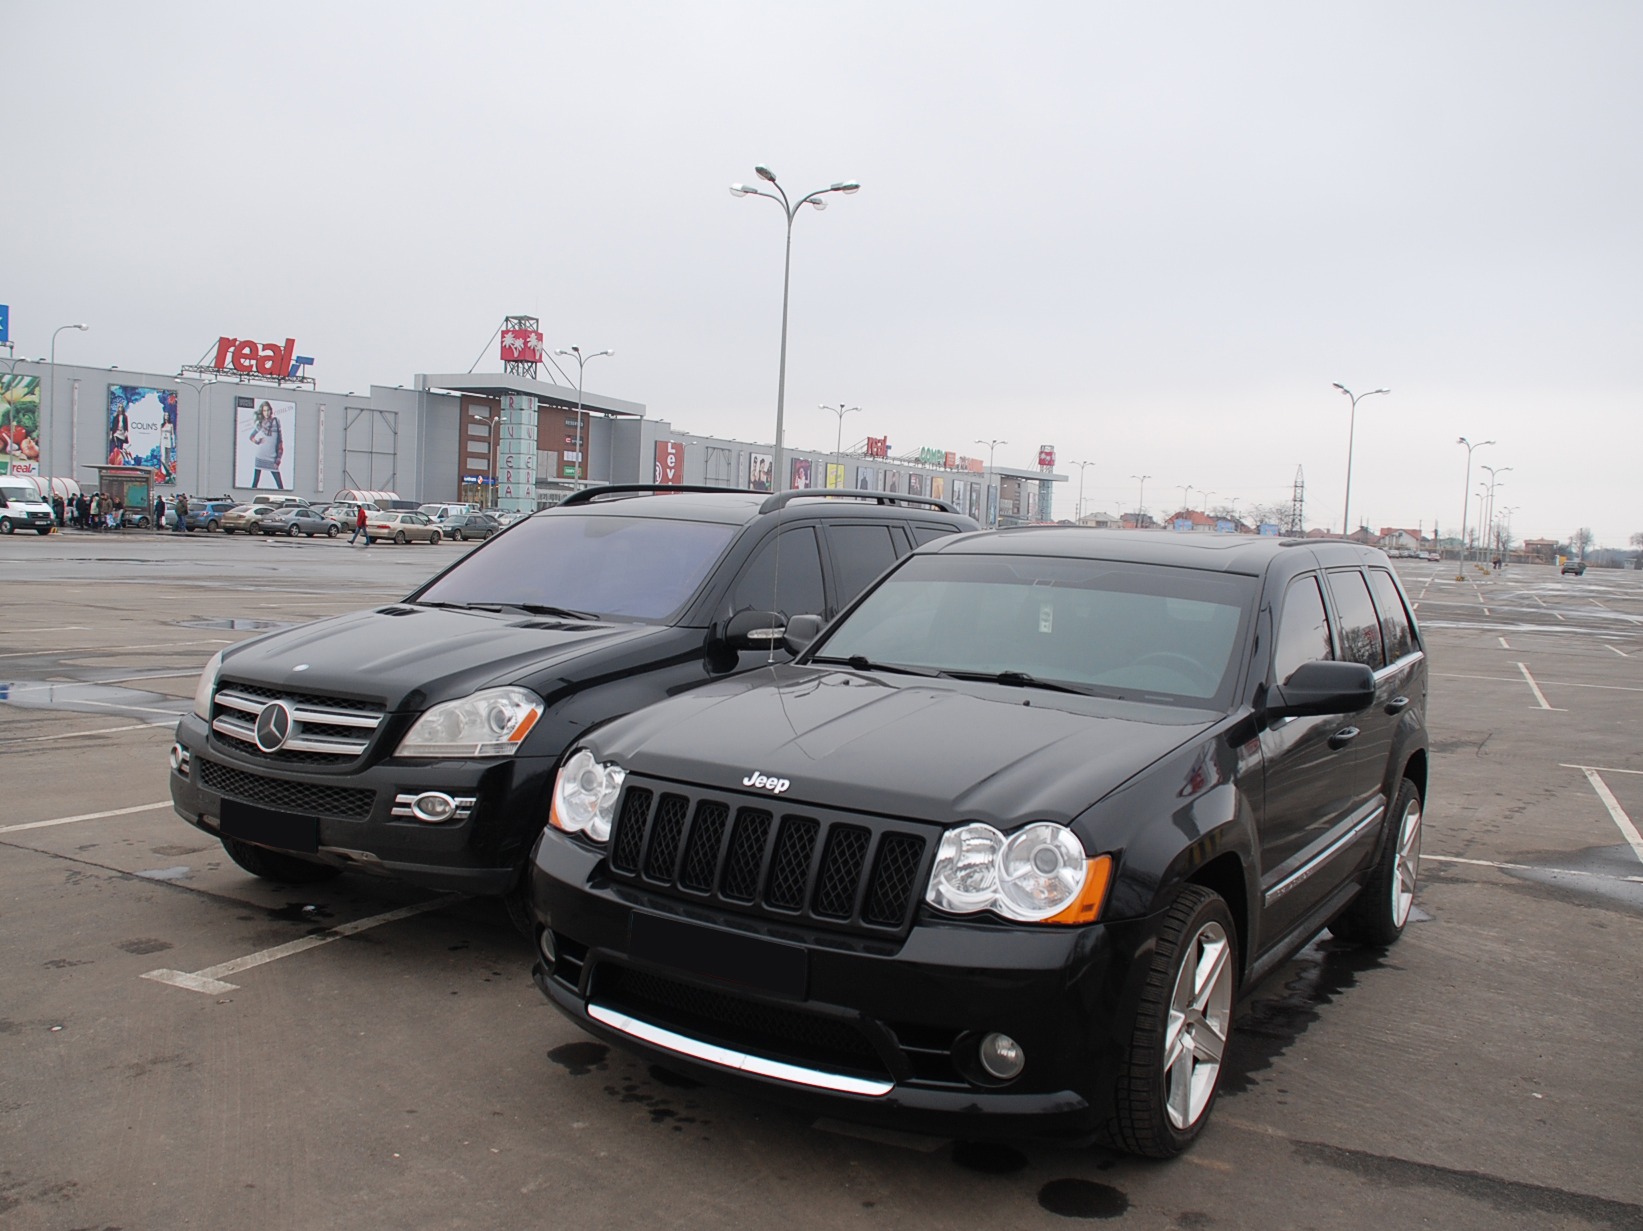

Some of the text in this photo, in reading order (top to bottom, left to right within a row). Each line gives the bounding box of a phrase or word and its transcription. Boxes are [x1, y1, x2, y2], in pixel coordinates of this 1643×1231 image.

[131, 421, 158, 430] COLIN'S
[504, 396, 514, 498] RIVIERA
[743, 771, 790, 794] Jeep
